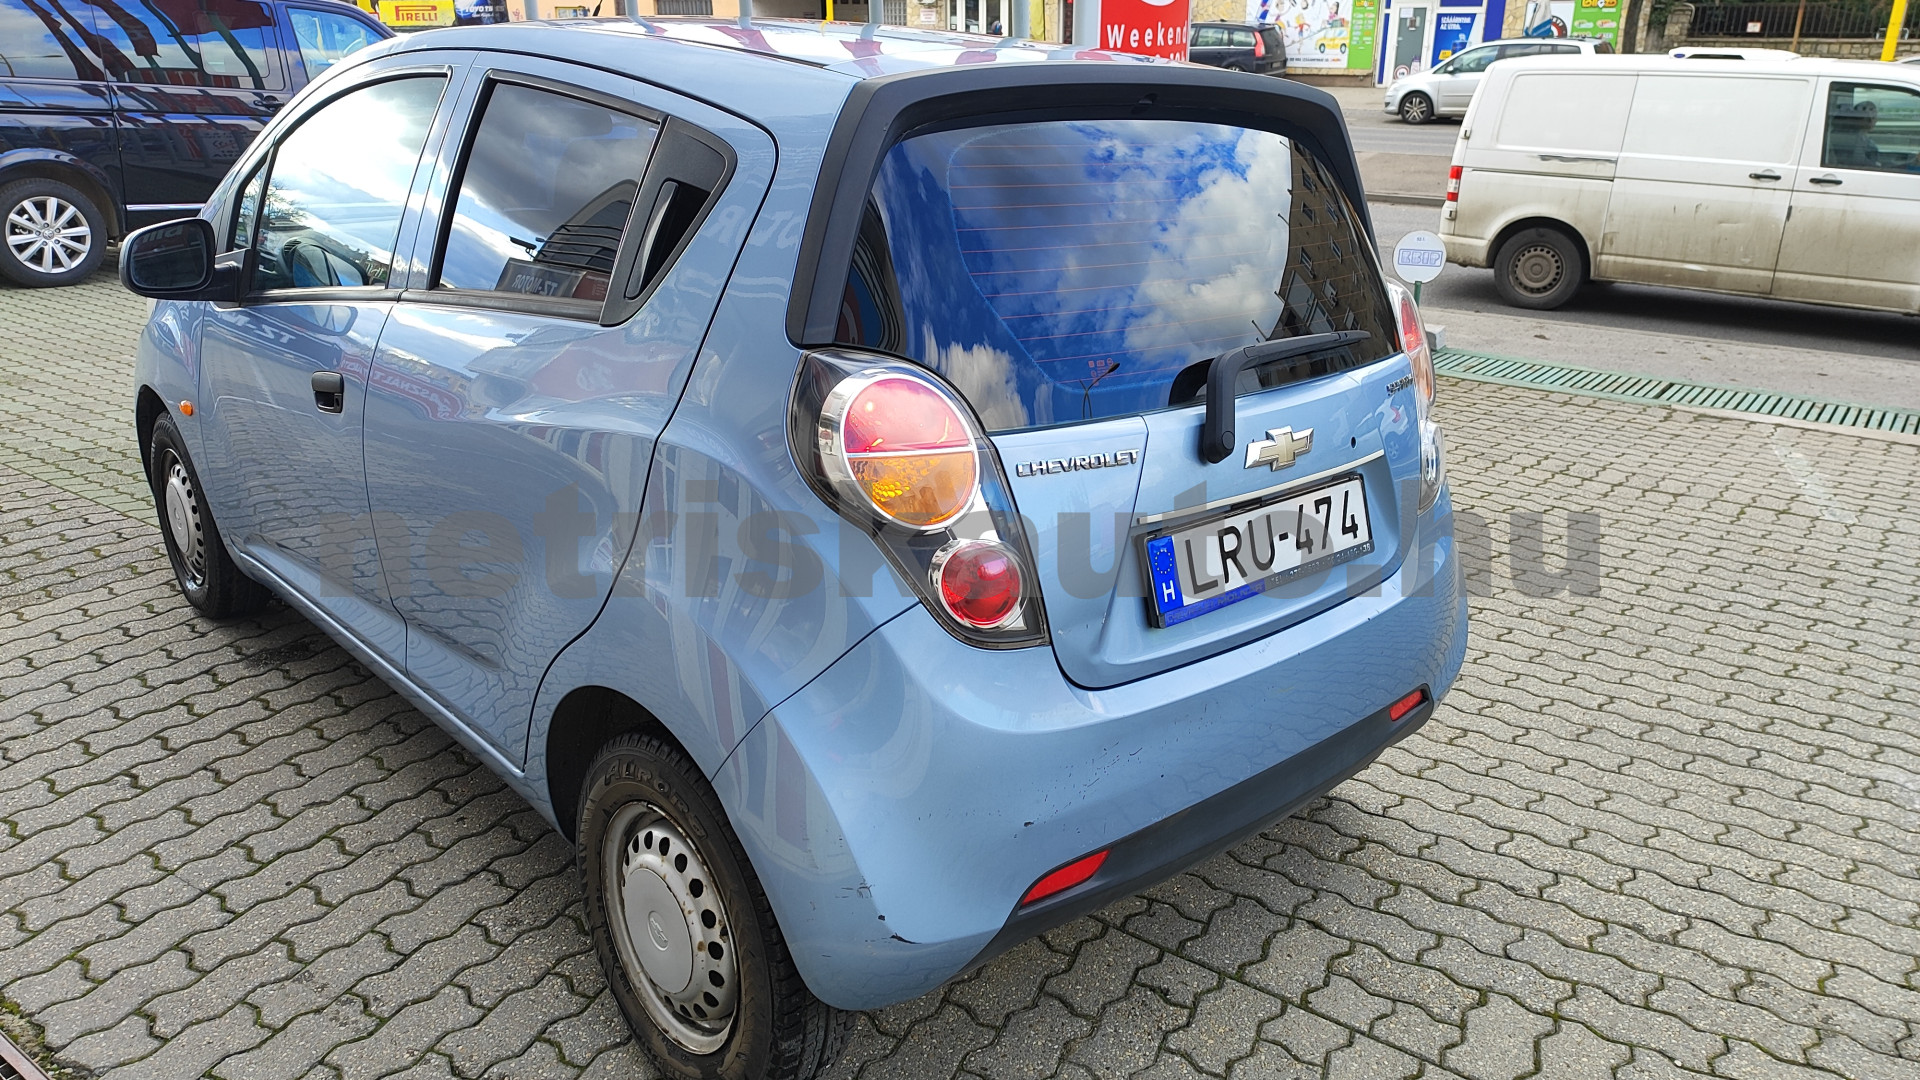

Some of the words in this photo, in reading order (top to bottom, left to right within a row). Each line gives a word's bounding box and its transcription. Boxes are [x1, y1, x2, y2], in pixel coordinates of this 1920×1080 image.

[395, 5, 437, 21] PIRELLI
[1107, 20, 1187, 48] Weekend
[1016, 449, 1139, 477] CHEVROLET
[1185, 490, 1359, 594] LRU-474
[1162, 580, 1176, 603] H
